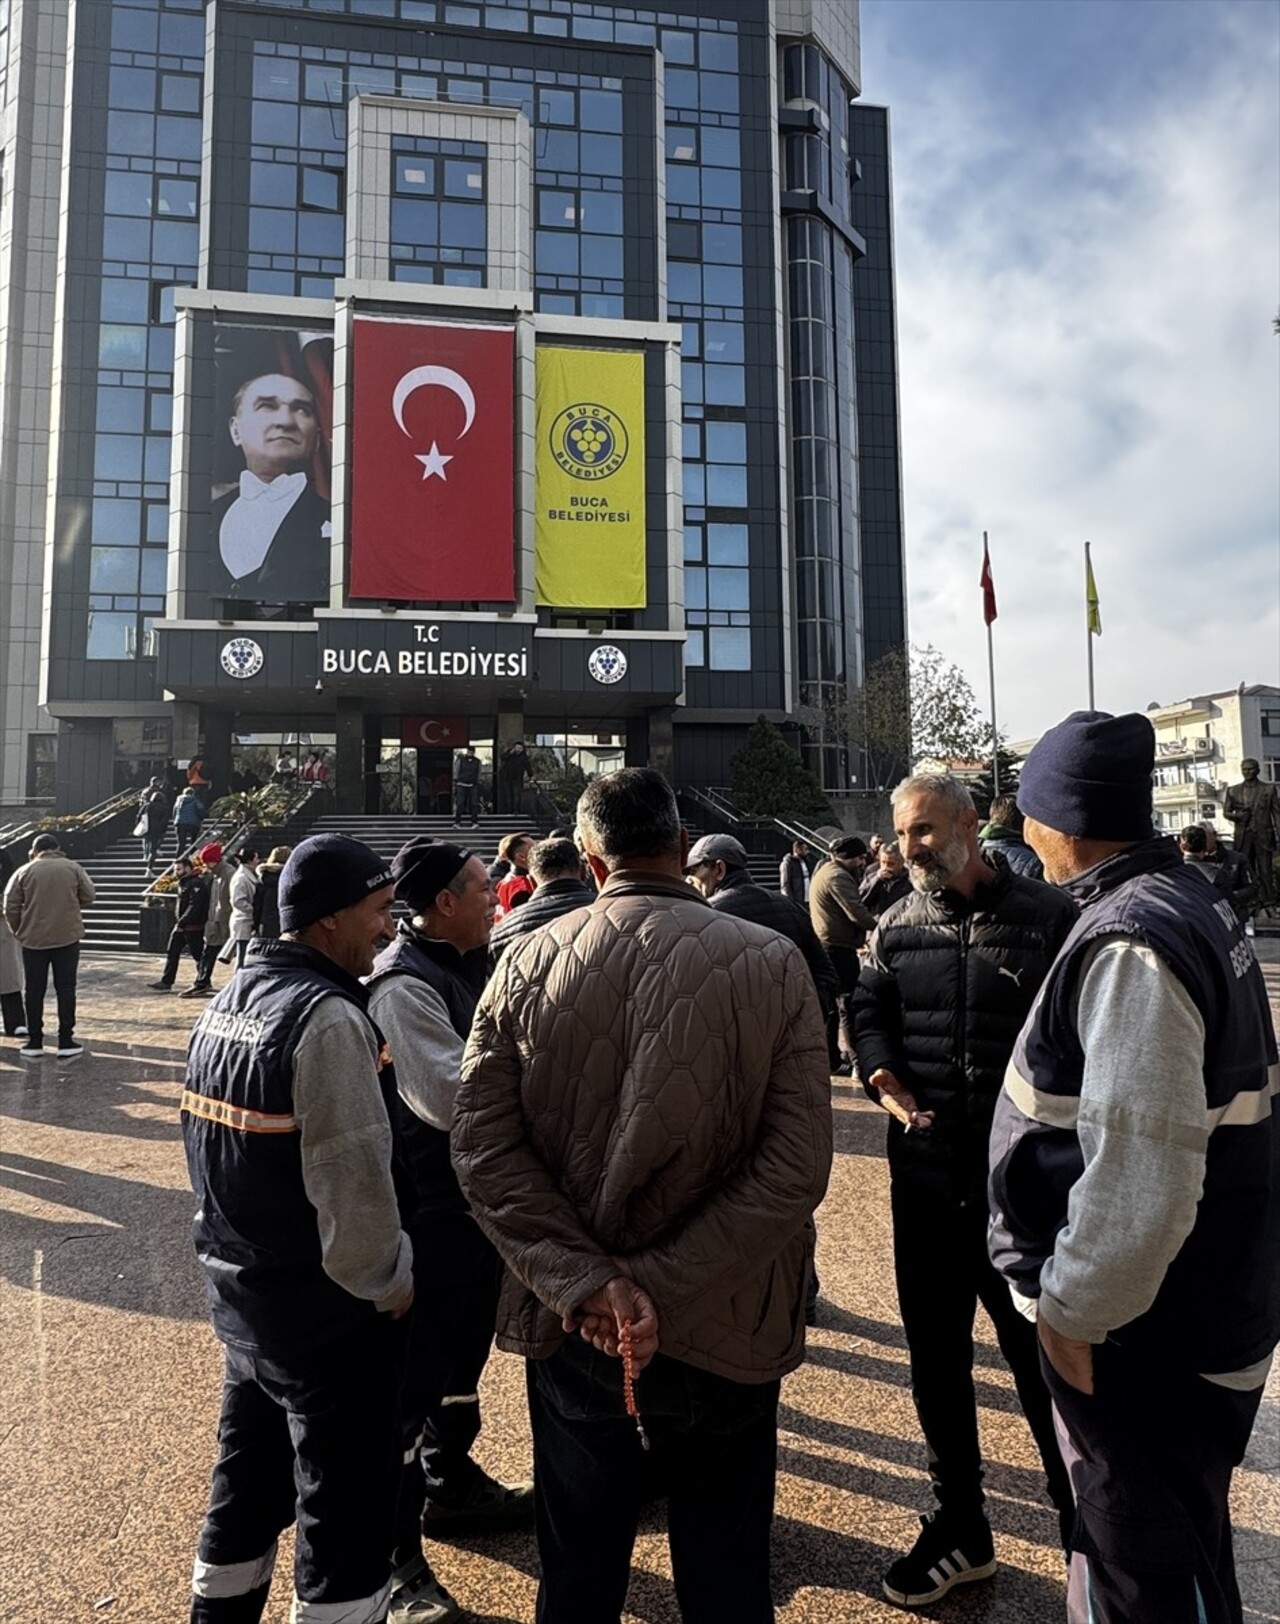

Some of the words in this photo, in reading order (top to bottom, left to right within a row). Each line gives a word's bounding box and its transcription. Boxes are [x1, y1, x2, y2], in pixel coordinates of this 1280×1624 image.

[565, 407, 612, 424] BUCA
[569, 495, 609, 508] BUCA
[548, 508, 631, 523] BELEDİYESİ
[413, 624, 440, 643] T.C
[323, 648, 391, 675] BUCA
[398, 646, 528, 677] BELEDİYESİ
